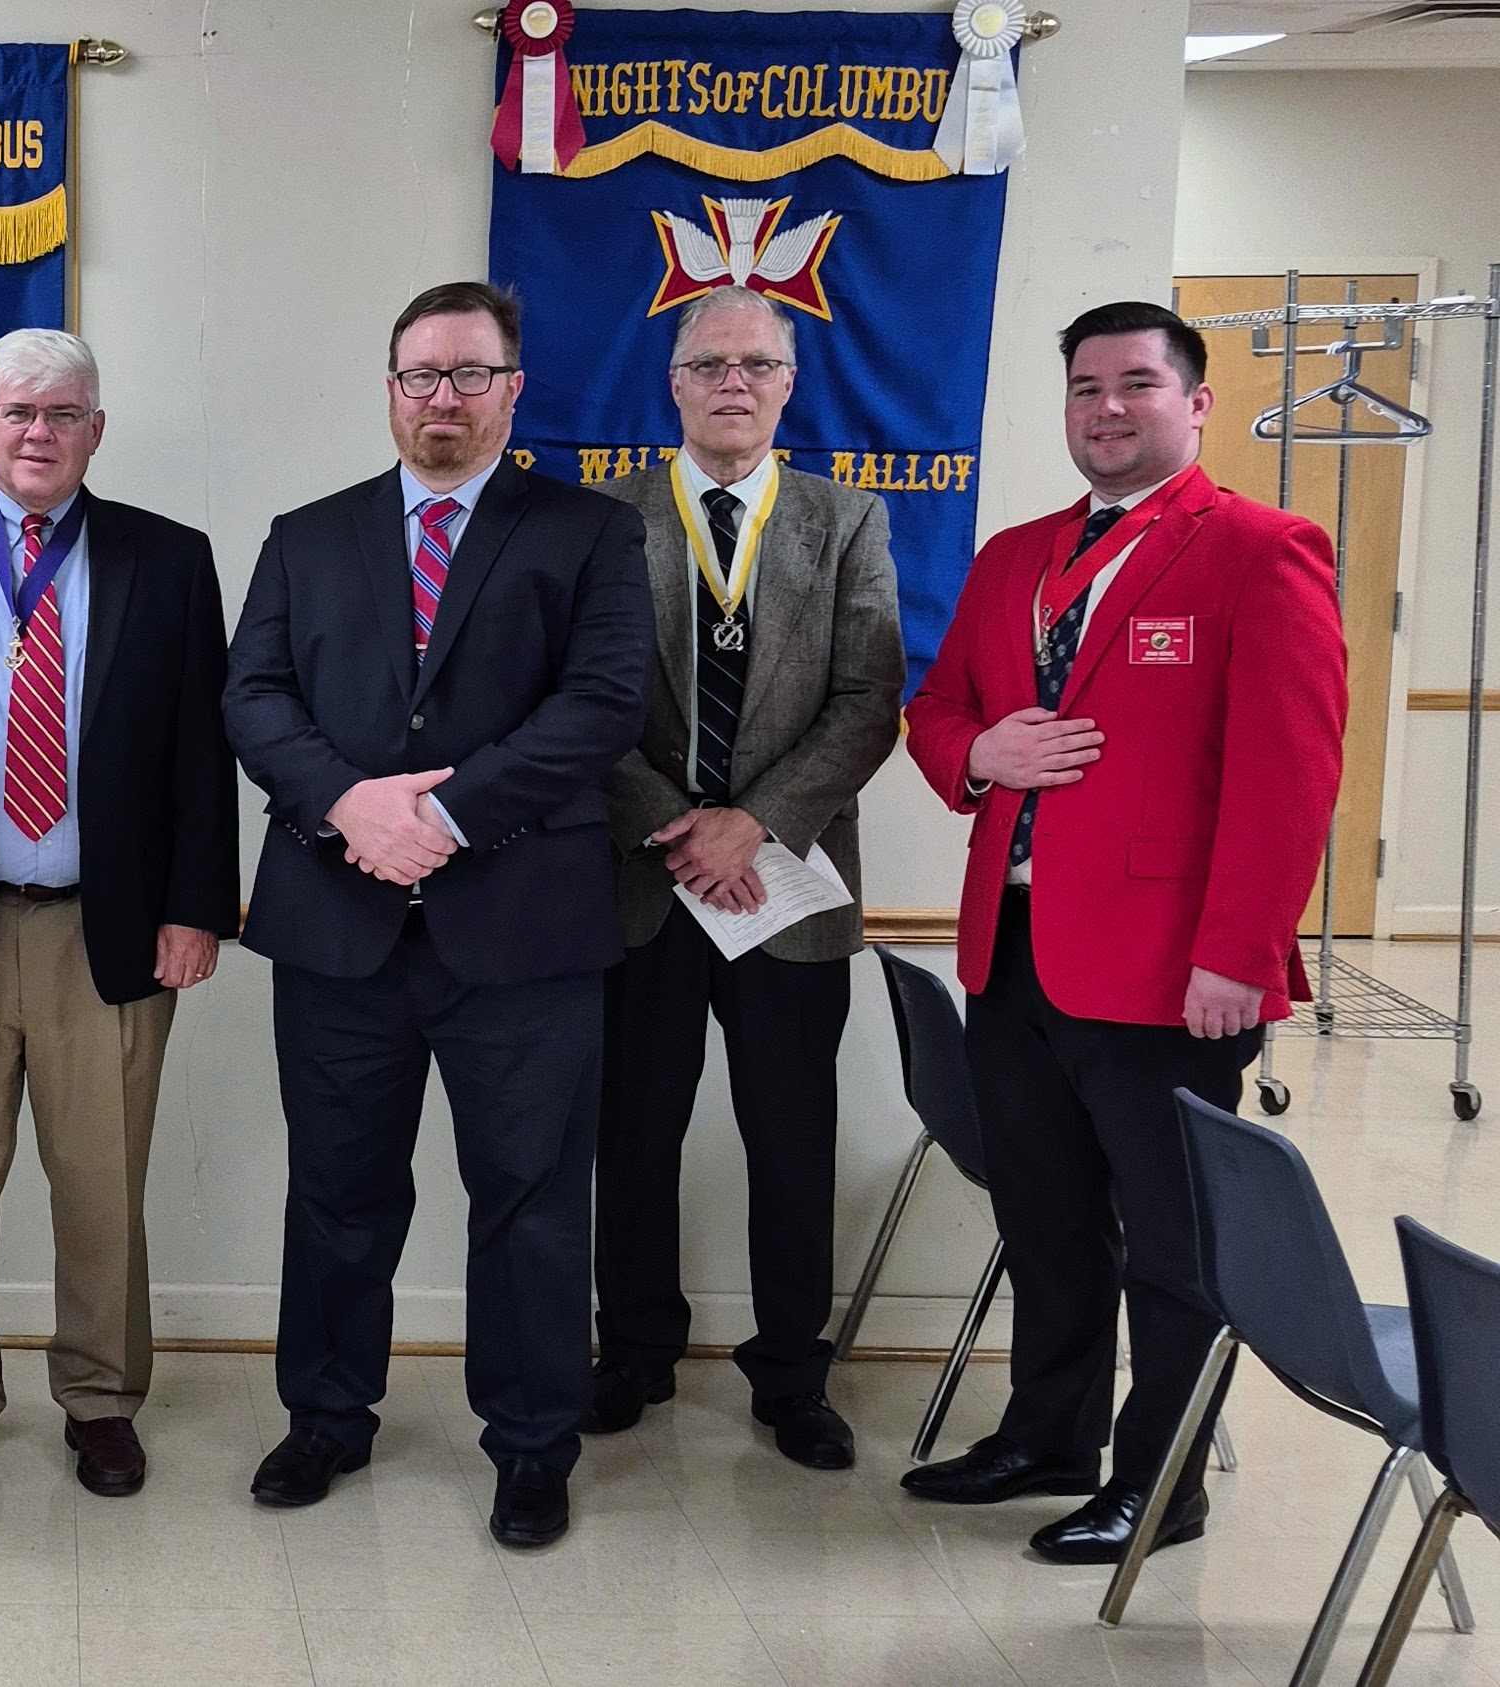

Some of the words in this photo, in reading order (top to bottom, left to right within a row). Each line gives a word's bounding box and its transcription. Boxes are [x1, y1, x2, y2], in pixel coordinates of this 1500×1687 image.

[568, 59, 712, 117] NIGHTS
[759, 63, 950, 123] COLUMBU
[830, 451, 976, 492] MALLOY
